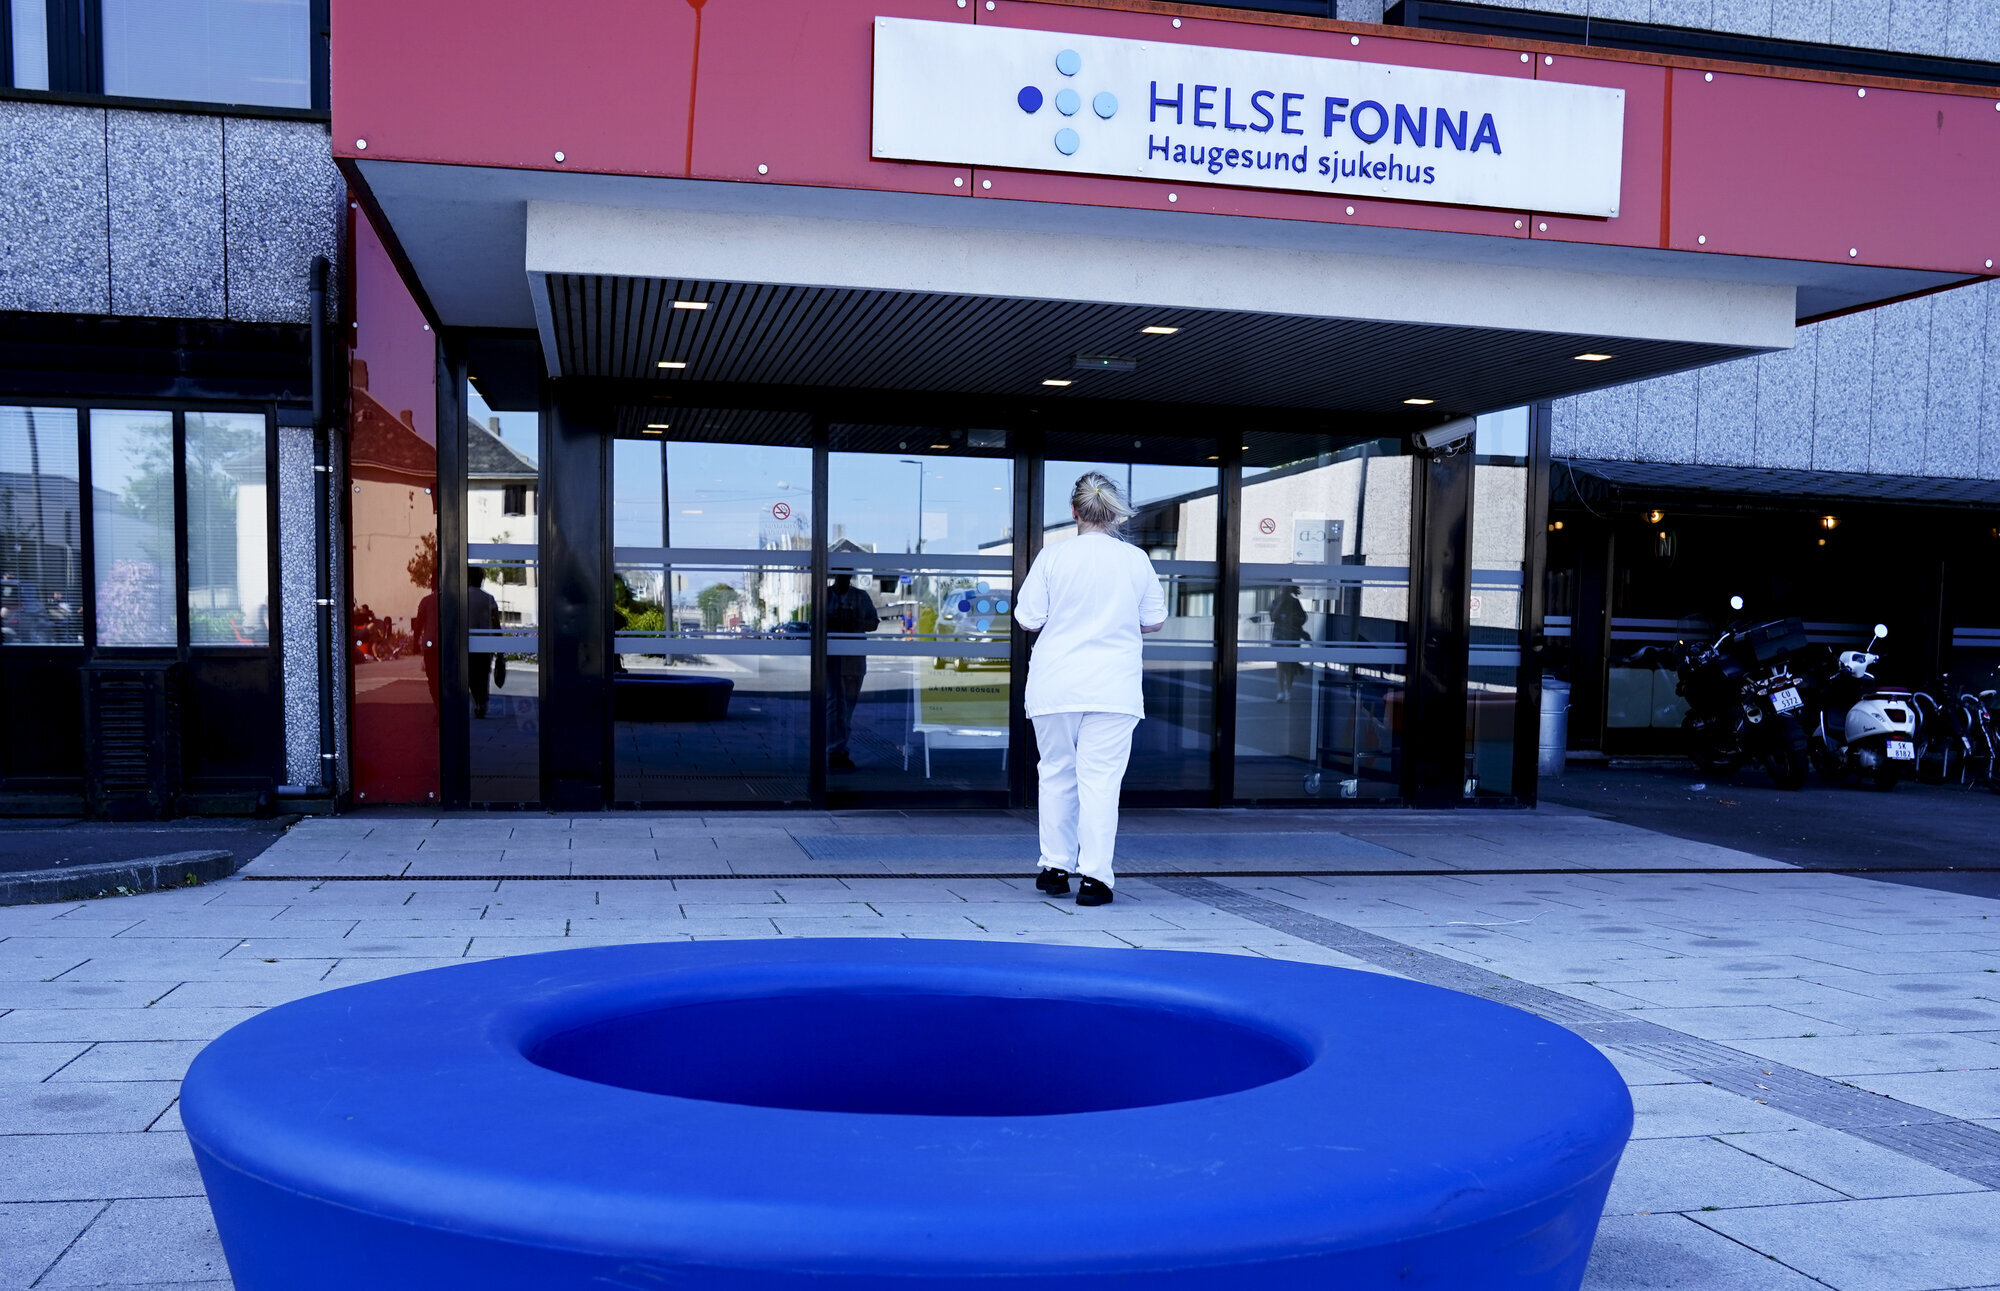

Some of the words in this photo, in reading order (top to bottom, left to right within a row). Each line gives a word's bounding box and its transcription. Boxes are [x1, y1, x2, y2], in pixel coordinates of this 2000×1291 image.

[1149, 80, 1305, 135] HELSE
[1324, 96, 1502, 155] FONNA
[1148, 134, 1308, 175] Haugesund
[1318, 150, 1436, 184] sjukehus
[1781, 690, 1791, 699] CU
[1781, 696, 1798, 707] 5372
